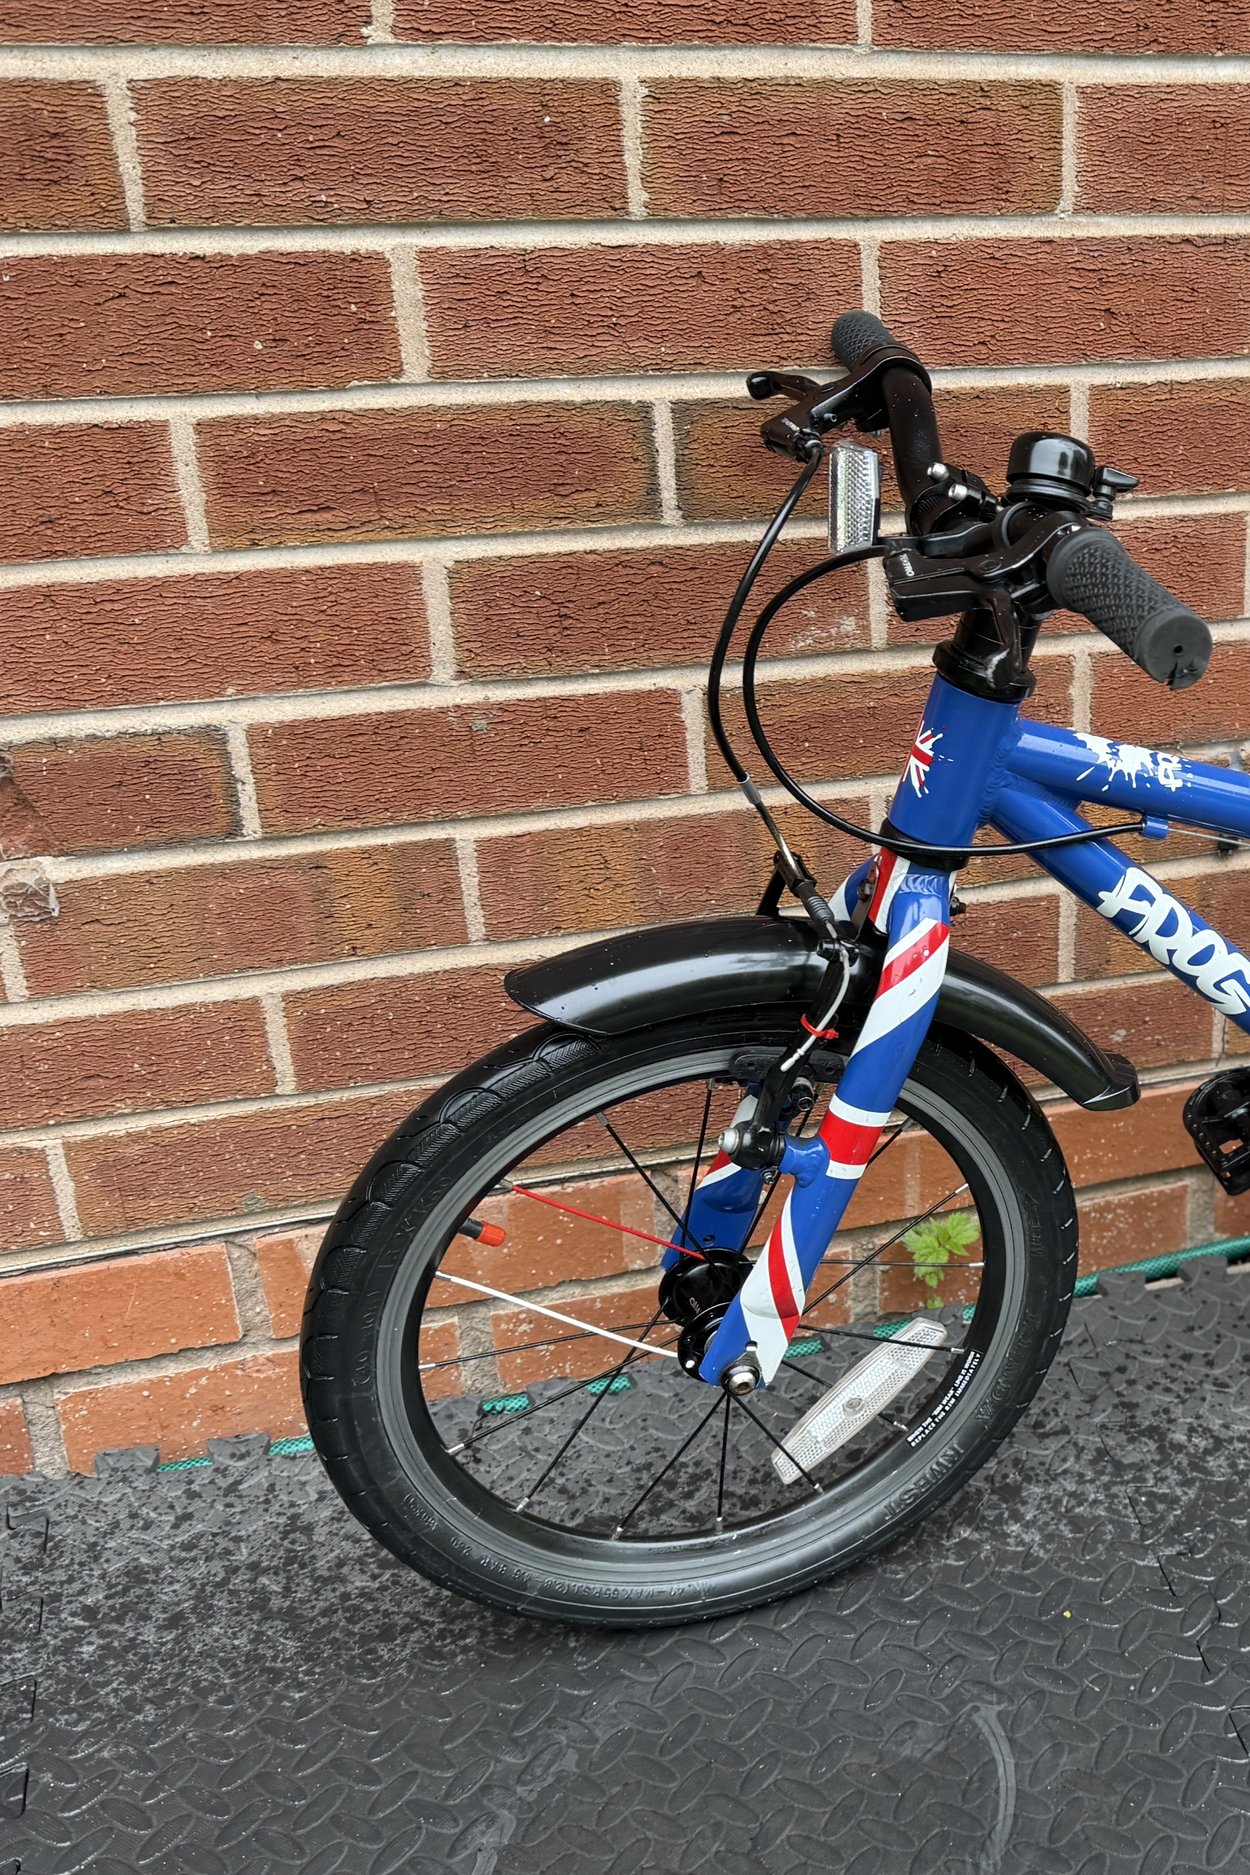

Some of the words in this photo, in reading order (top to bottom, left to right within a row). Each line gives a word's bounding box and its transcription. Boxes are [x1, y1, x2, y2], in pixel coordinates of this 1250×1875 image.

[910, 1422, 936, 1447] REPLACE
[934, 1411, 946, 1423] THE
[944, 1397, 956, 1411] RIM
[954, 1353, 981, 1397] IMMEDIATELY
